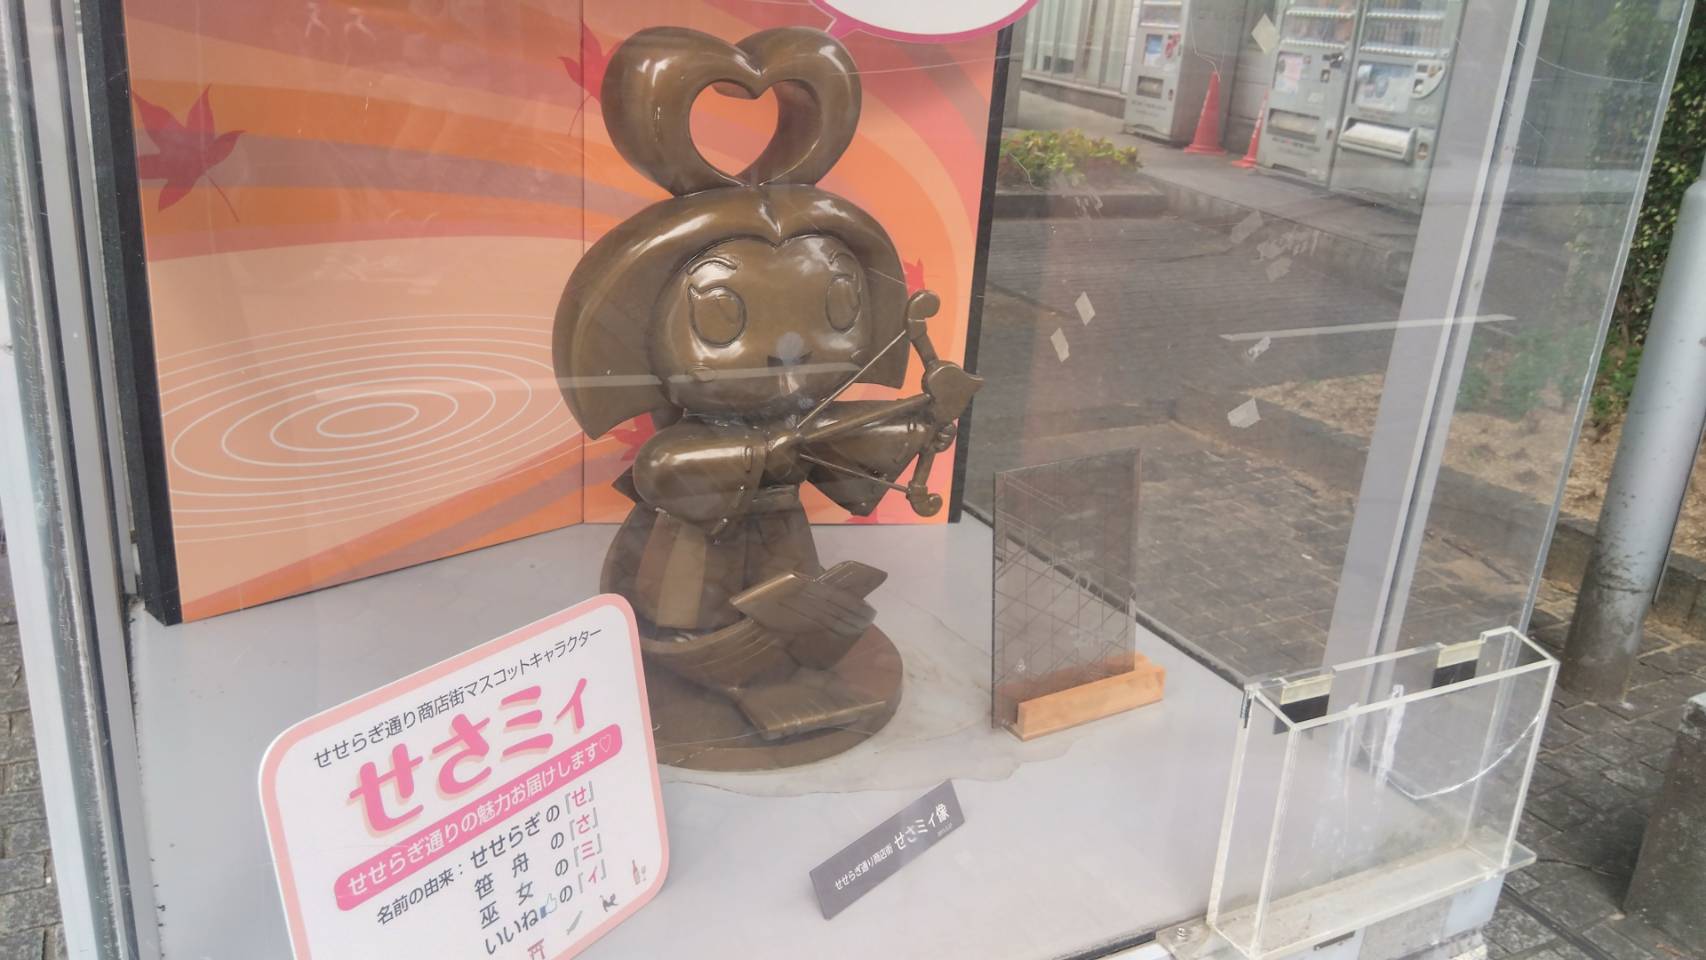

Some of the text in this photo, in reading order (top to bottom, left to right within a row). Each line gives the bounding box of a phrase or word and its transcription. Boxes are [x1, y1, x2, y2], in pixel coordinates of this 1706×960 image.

[313, 628, 602, 769] せせらぎ通り商店街マスコットキャラクター
[834, 843, 894, 890] せせらぎ通り商店街
